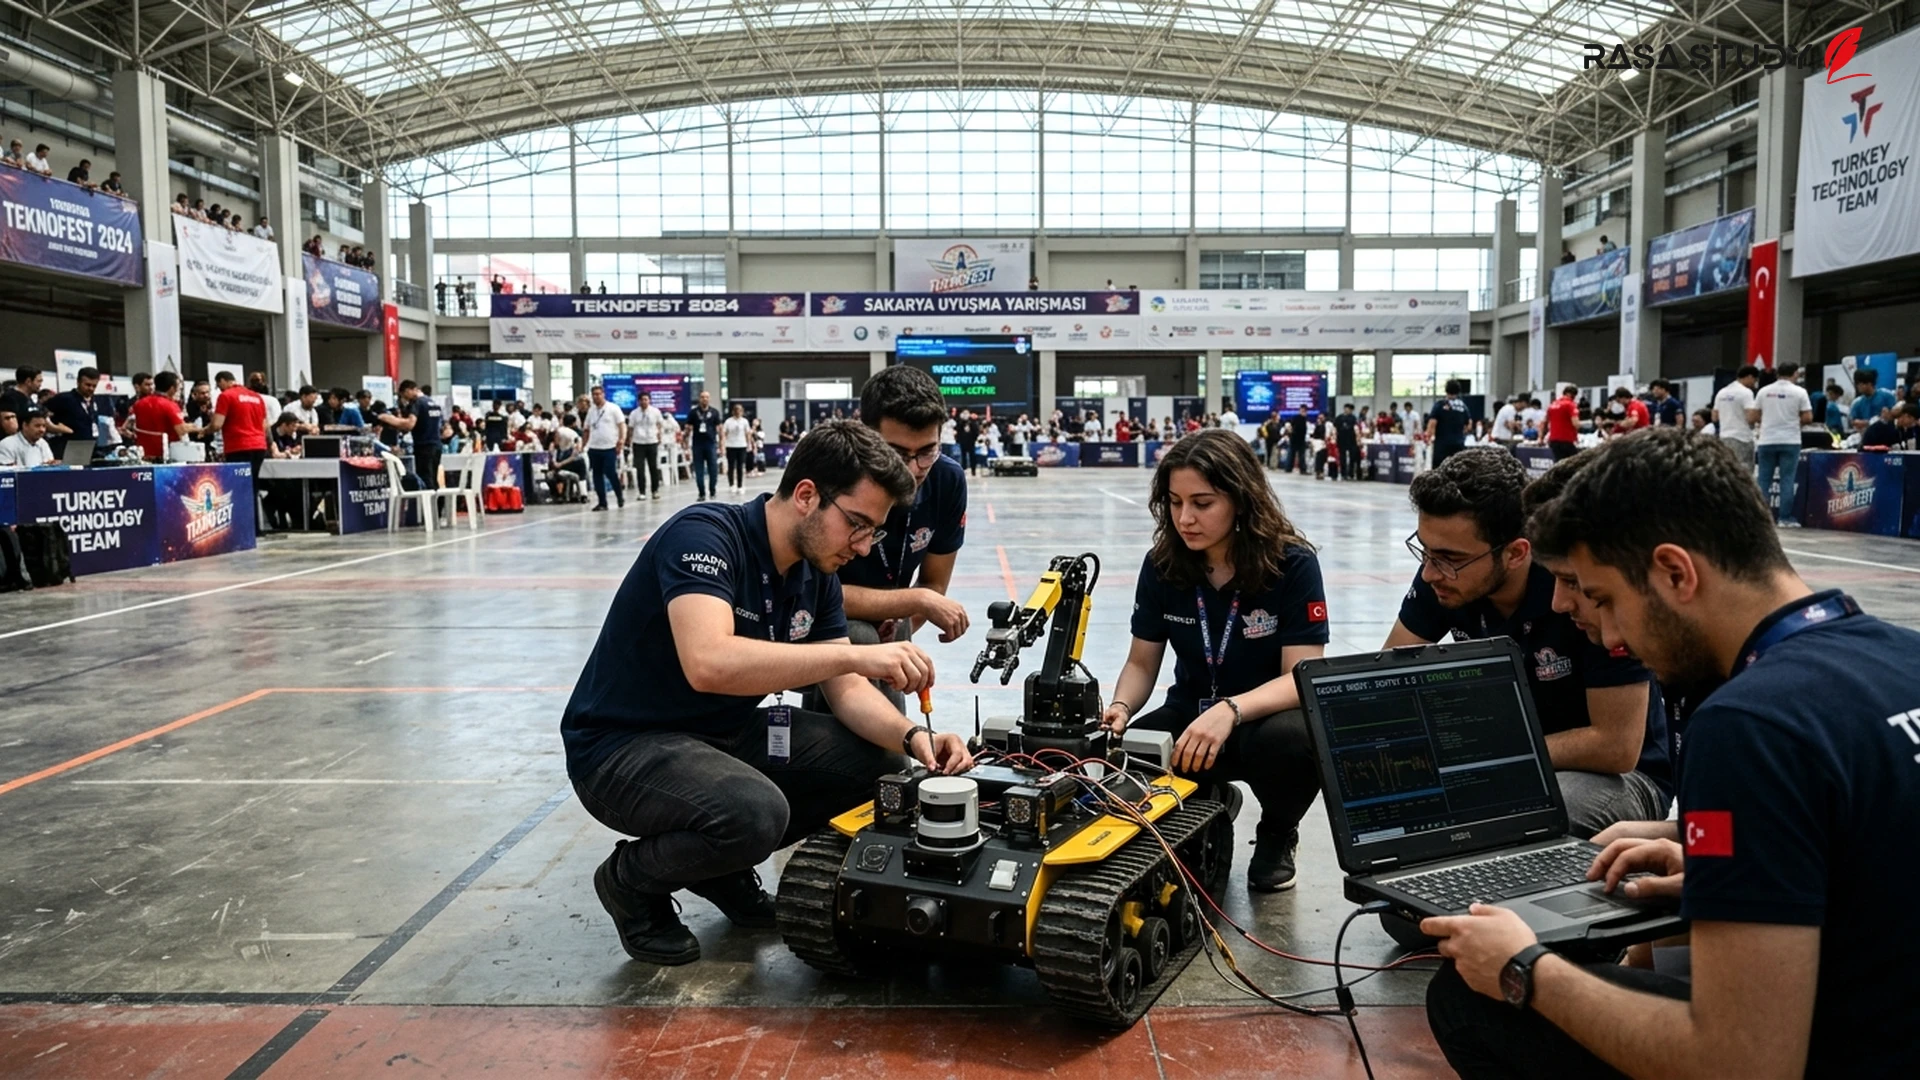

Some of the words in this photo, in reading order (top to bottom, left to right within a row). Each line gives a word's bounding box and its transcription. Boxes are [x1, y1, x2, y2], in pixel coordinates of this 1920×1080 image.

[1832, 142, 1891, 177] TURKEY
[1812, 156, 1909, 202] TECHNOLOGY
[1837, 187, 1878, 214] TEAM
[2, 200, 94, 246] TEKNOFEST
[97, 223, 133, 254] 2024
[688, 299, 740, 313] 2024
[863, 298, 935, 312] SAKARYA
[938, 297, 1002, 314] UYUŞMA
[1005, 296, 1086, 313] YARIŞMASI
[52, 489, 127, 513] TURKEY
[36, 508, 143, 533] CHNOLOGY
[68, 530, 120, 553] TEAM
